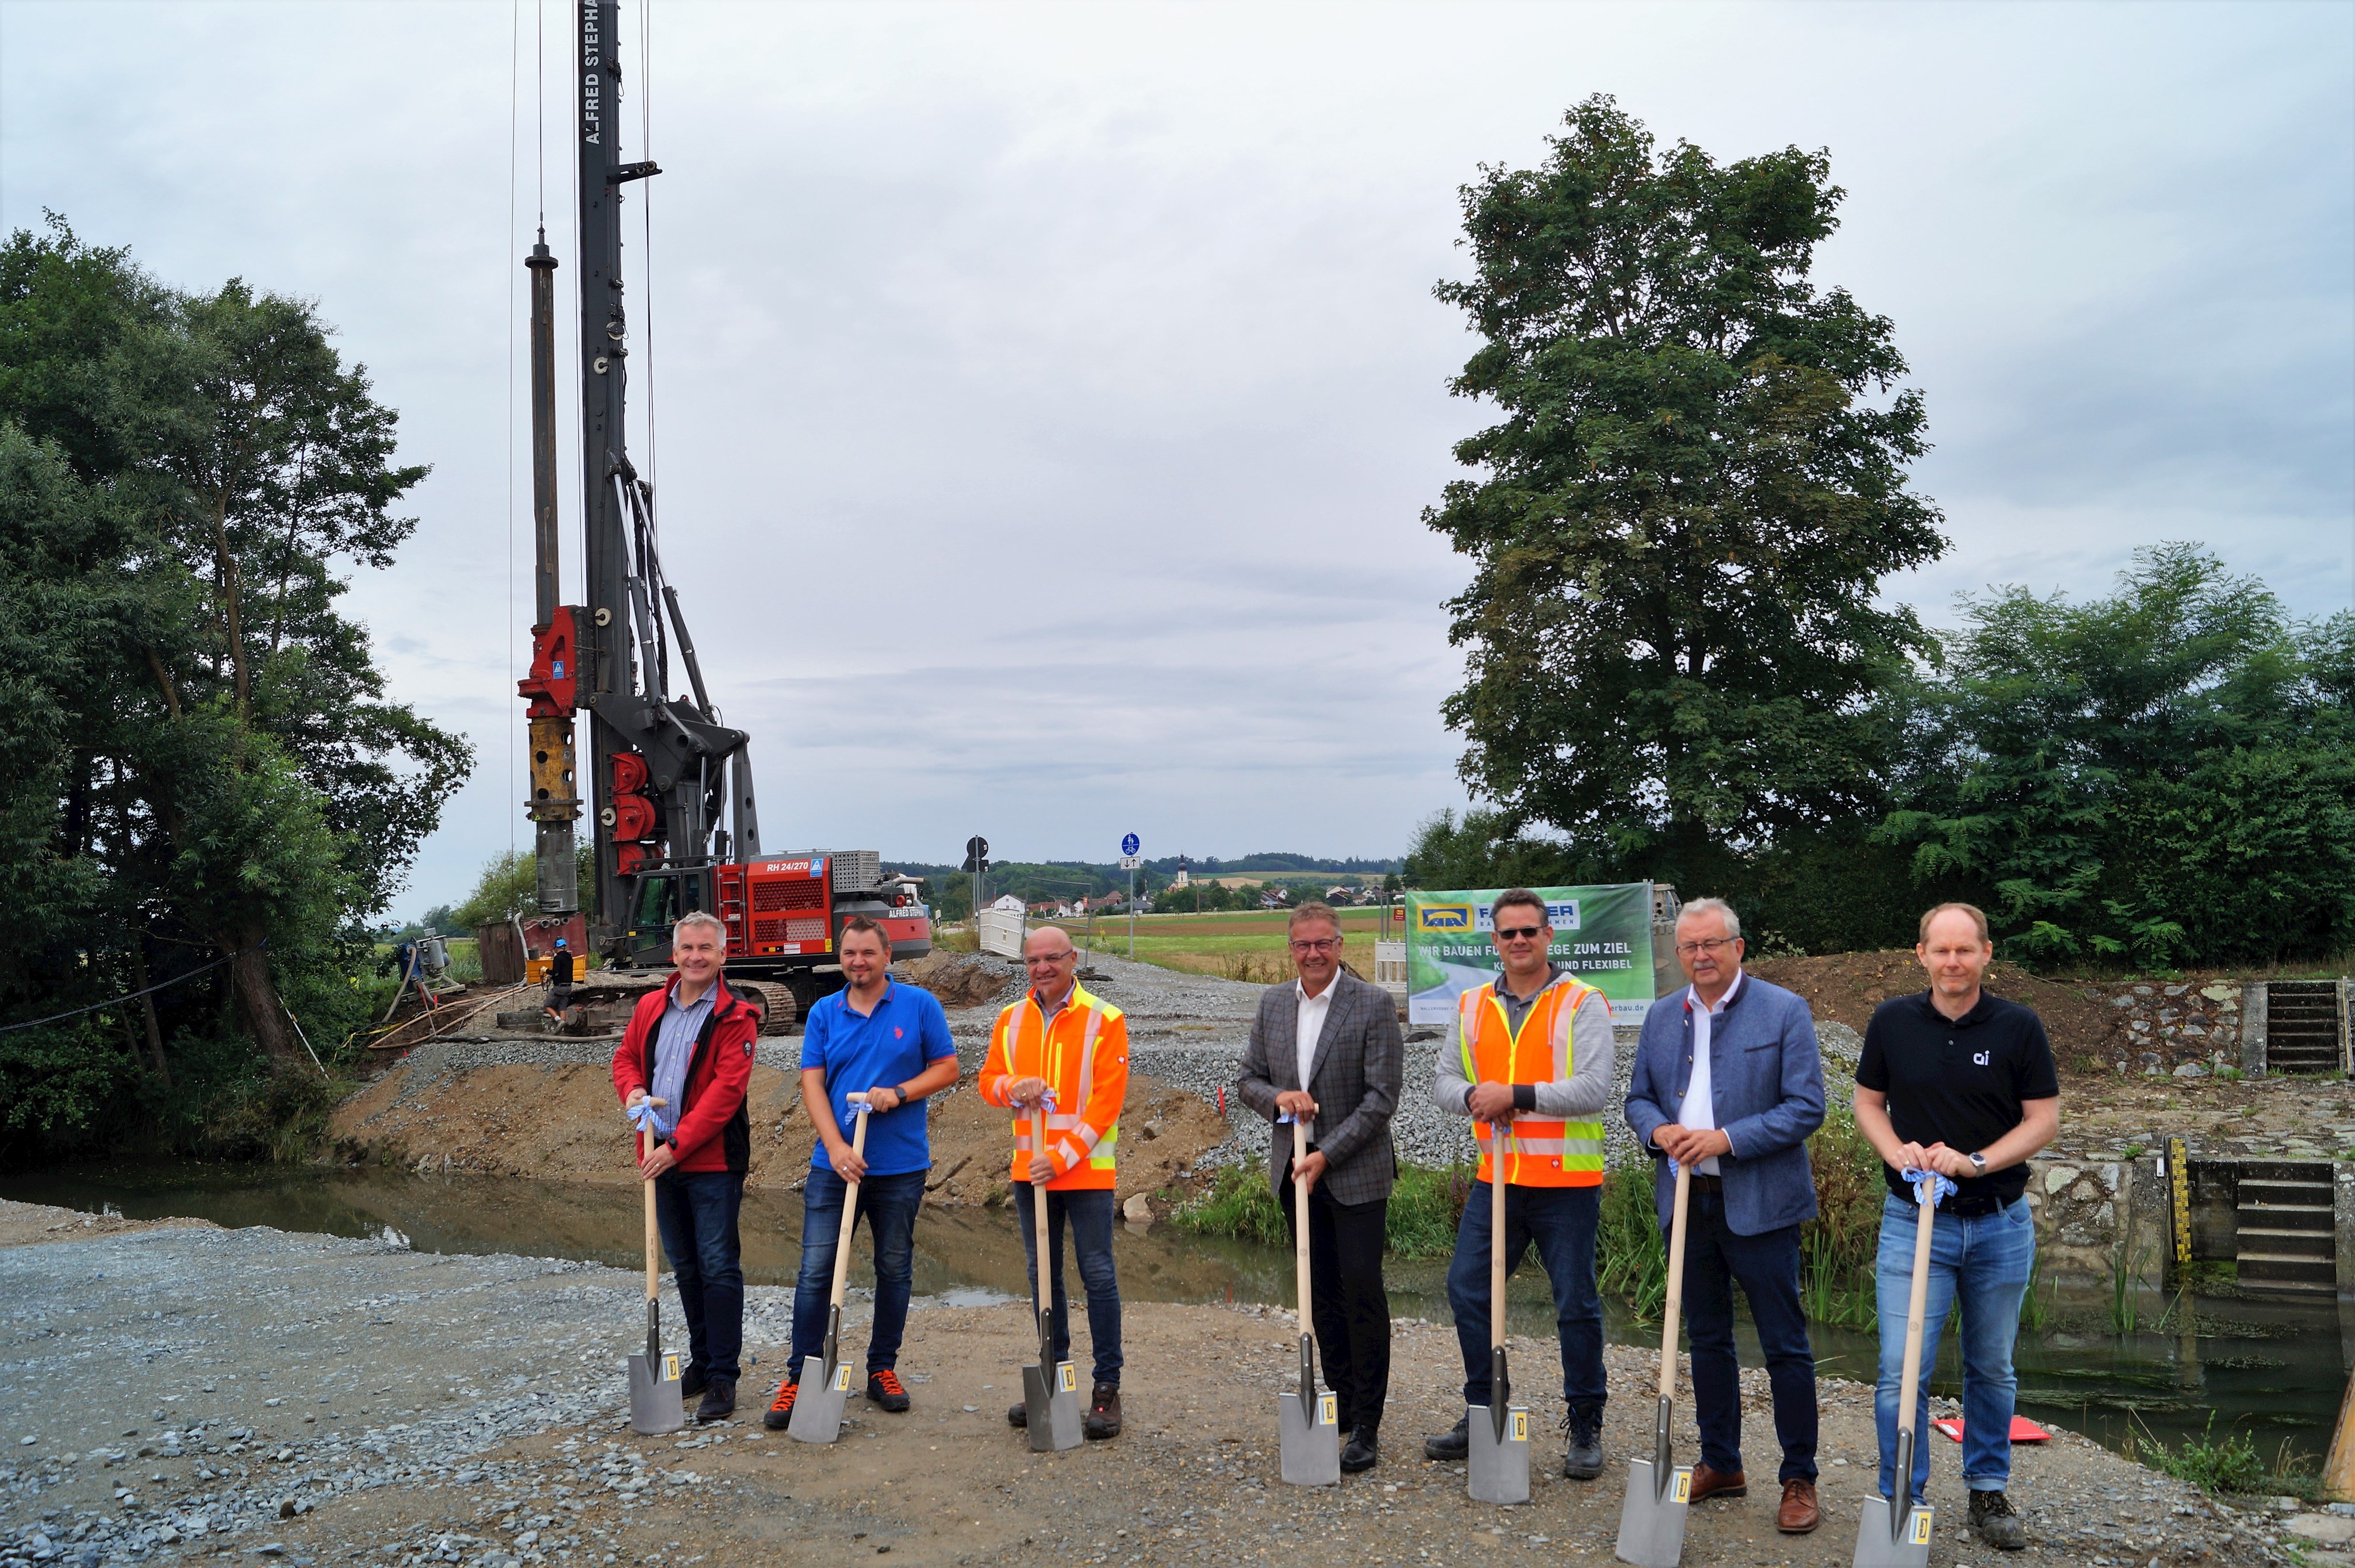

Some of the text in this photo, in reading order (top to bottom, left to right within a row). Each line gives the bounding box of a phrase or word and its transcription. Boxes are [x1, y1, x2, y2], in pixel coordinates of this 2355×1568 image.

[585, 74, 600, 144] ALFRED
[766, 864, 780, 872] RH
[781, 862, 809, 871] 24/270
[888, 908, 909, 918] ALFRED
[1418, 946, 1440, 956] WIR
[1443, 945, 1482, 956] BAUEN
[1574, 943, 1600, 954] ZUM
[1604, 942, 1632, 954] ZIEL
[1557, 959, 1633, 970] UND FLEXIBEL
